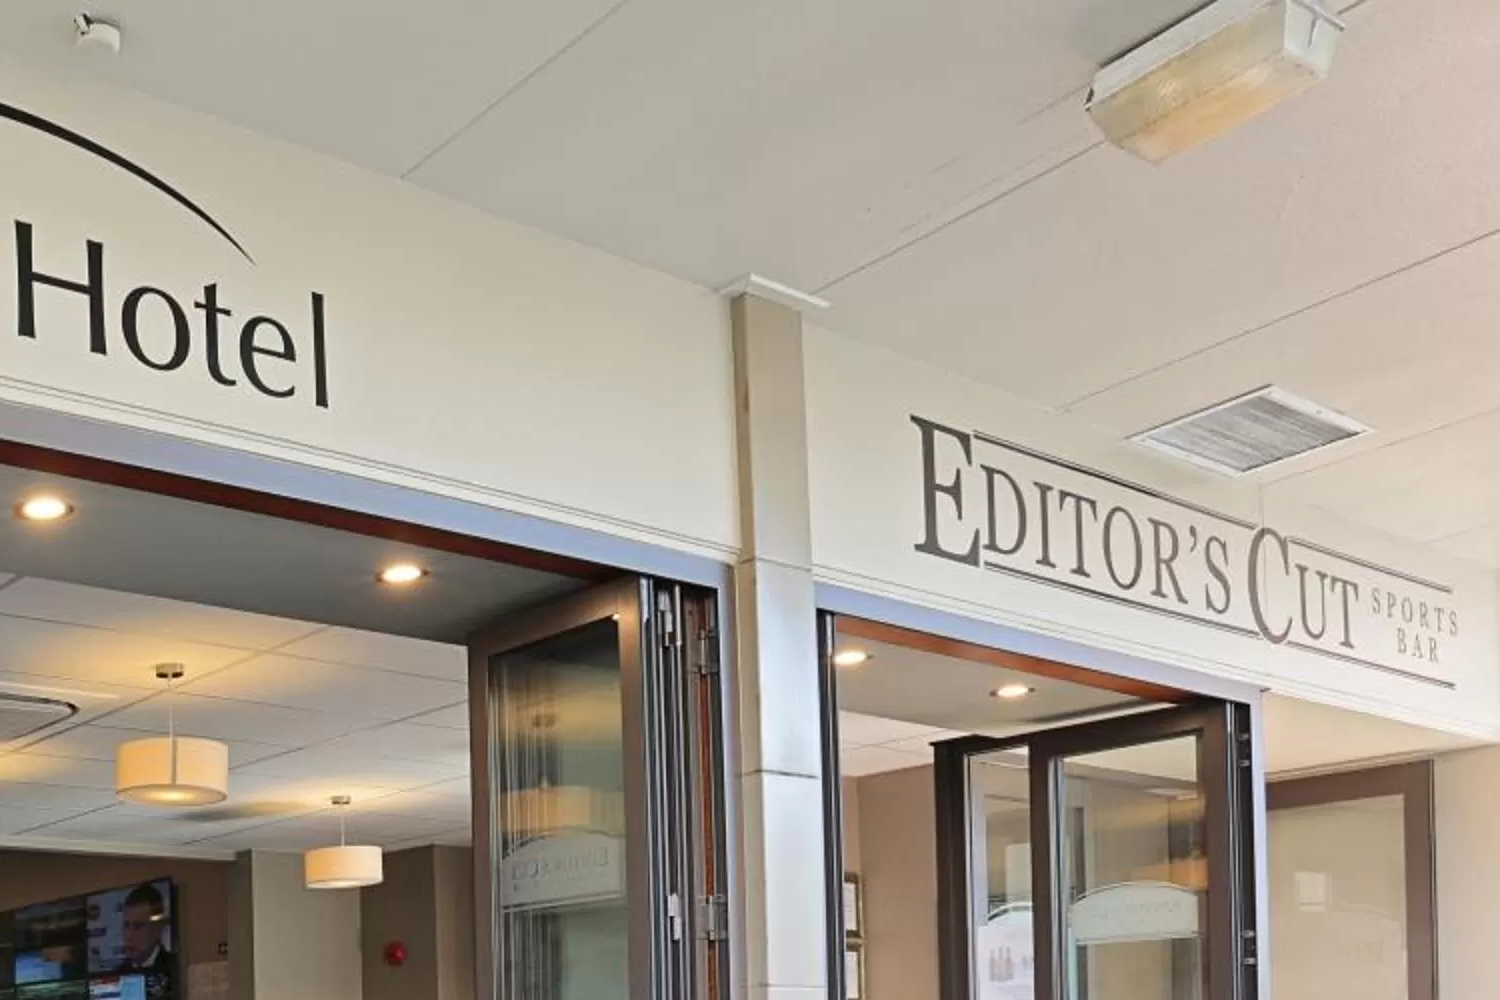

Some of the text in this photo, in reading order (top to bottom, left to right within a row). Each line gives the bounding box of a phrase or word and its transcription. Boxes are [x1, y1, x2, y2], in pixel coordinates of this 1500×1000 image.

[14, 219, 329, 409] Hotel
[910, 413, 1359, 649] EDITOR'S CUT
[1371, 586, 1458, 637] SPORTS
[1396, 627, 1439, 664] BAR
